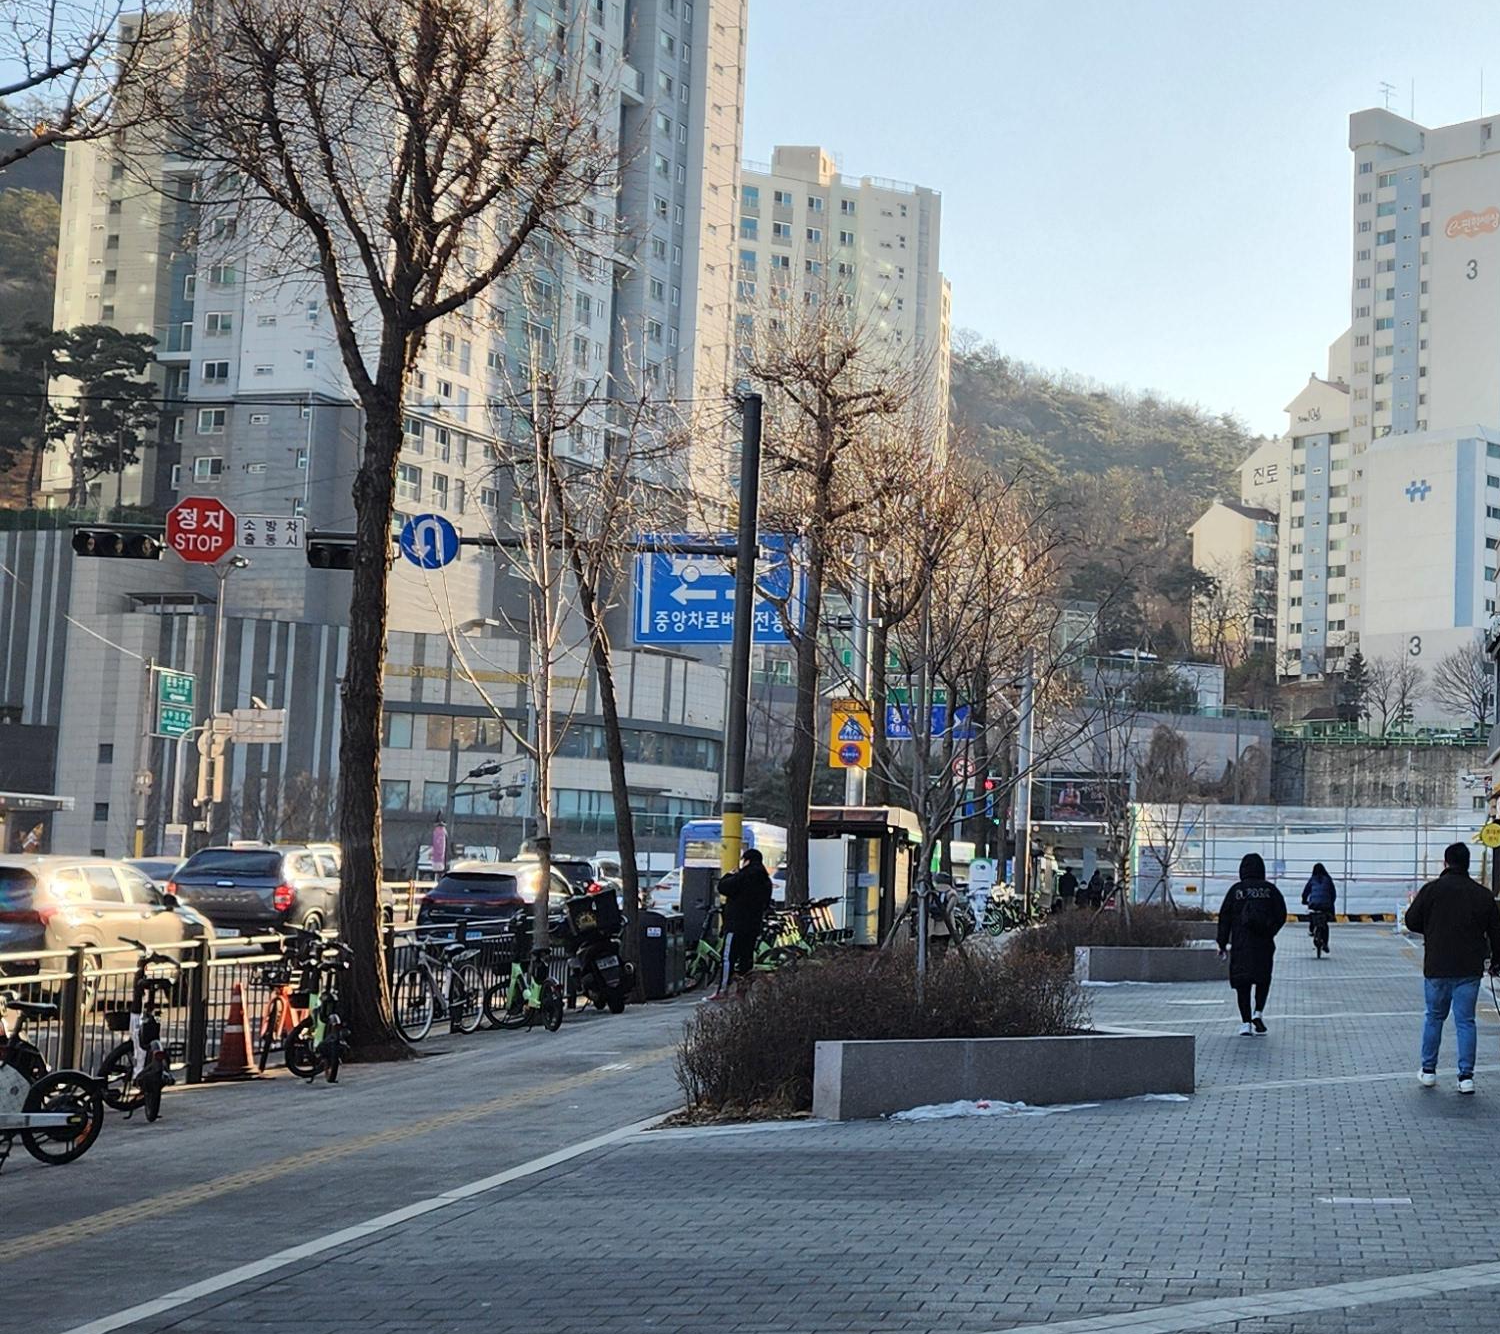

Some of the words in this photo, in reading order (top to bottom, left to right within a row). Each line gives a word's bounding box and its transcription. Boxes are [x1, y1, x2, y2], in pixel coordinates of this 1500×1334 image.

[1465, 259, 1478, 280] 3
[1252, 463, 1279, 487] 진로
[176, 507, 225, 532] 정지
[174, 532, 223, 552] STOP
[1408, 635, 1422, 656] 3
